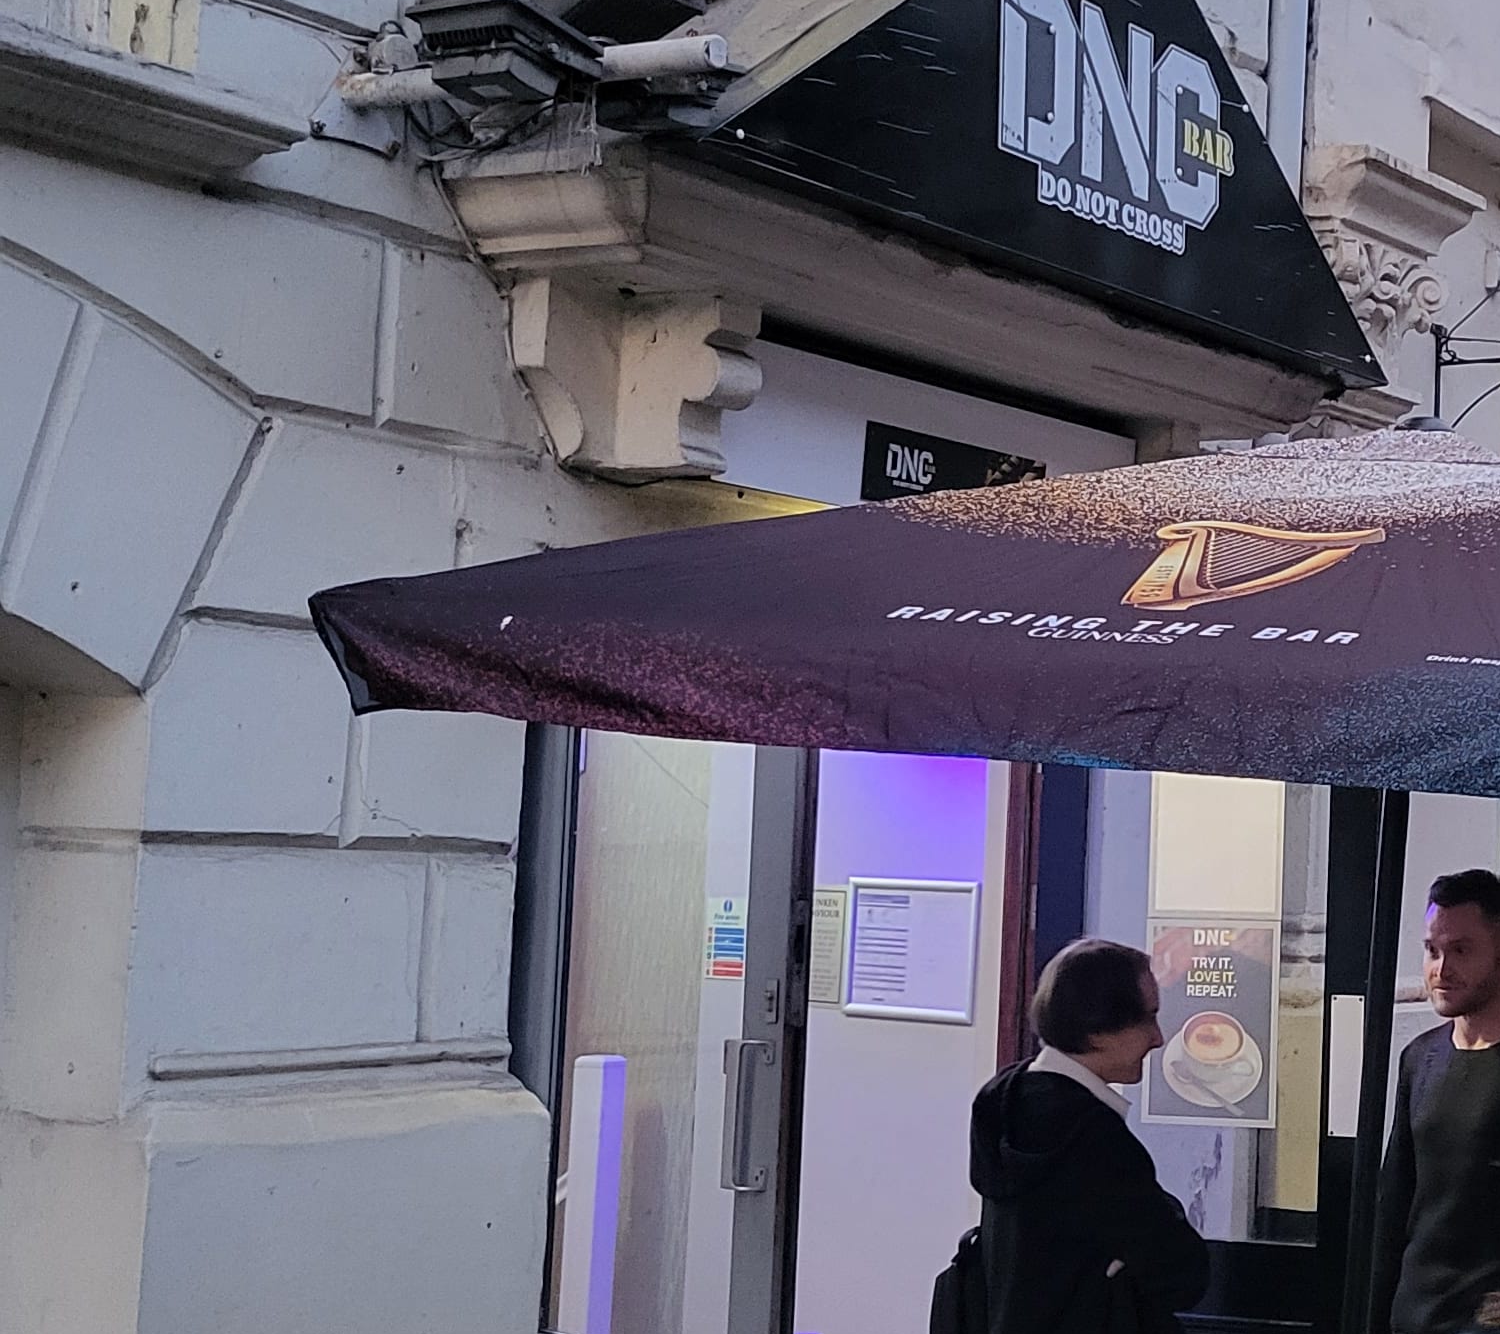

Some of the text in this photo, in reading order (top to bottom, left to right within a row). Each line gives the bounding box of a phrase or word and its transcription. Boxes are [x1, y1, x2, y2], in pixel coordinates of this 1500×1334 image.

[1182, 118, 1234, 172] BAR
[1040, 169, 1184, 250] DO NOT CROSS
[885, 443, 935, 485] DNC
[886, 605, 1361, 645] RAISING THE BAR
[1027, 627, 1179, 645] GUINNESS
[1425, 653, 1471, 664] Drink
[1192, 928, 1231, 947] DNC
[1191, 956, 1234, 970] TRY IT.
[1186, 970, 1237, 984] LOVE IT.
[1185, 984, 1238, 998] REPEAT.
